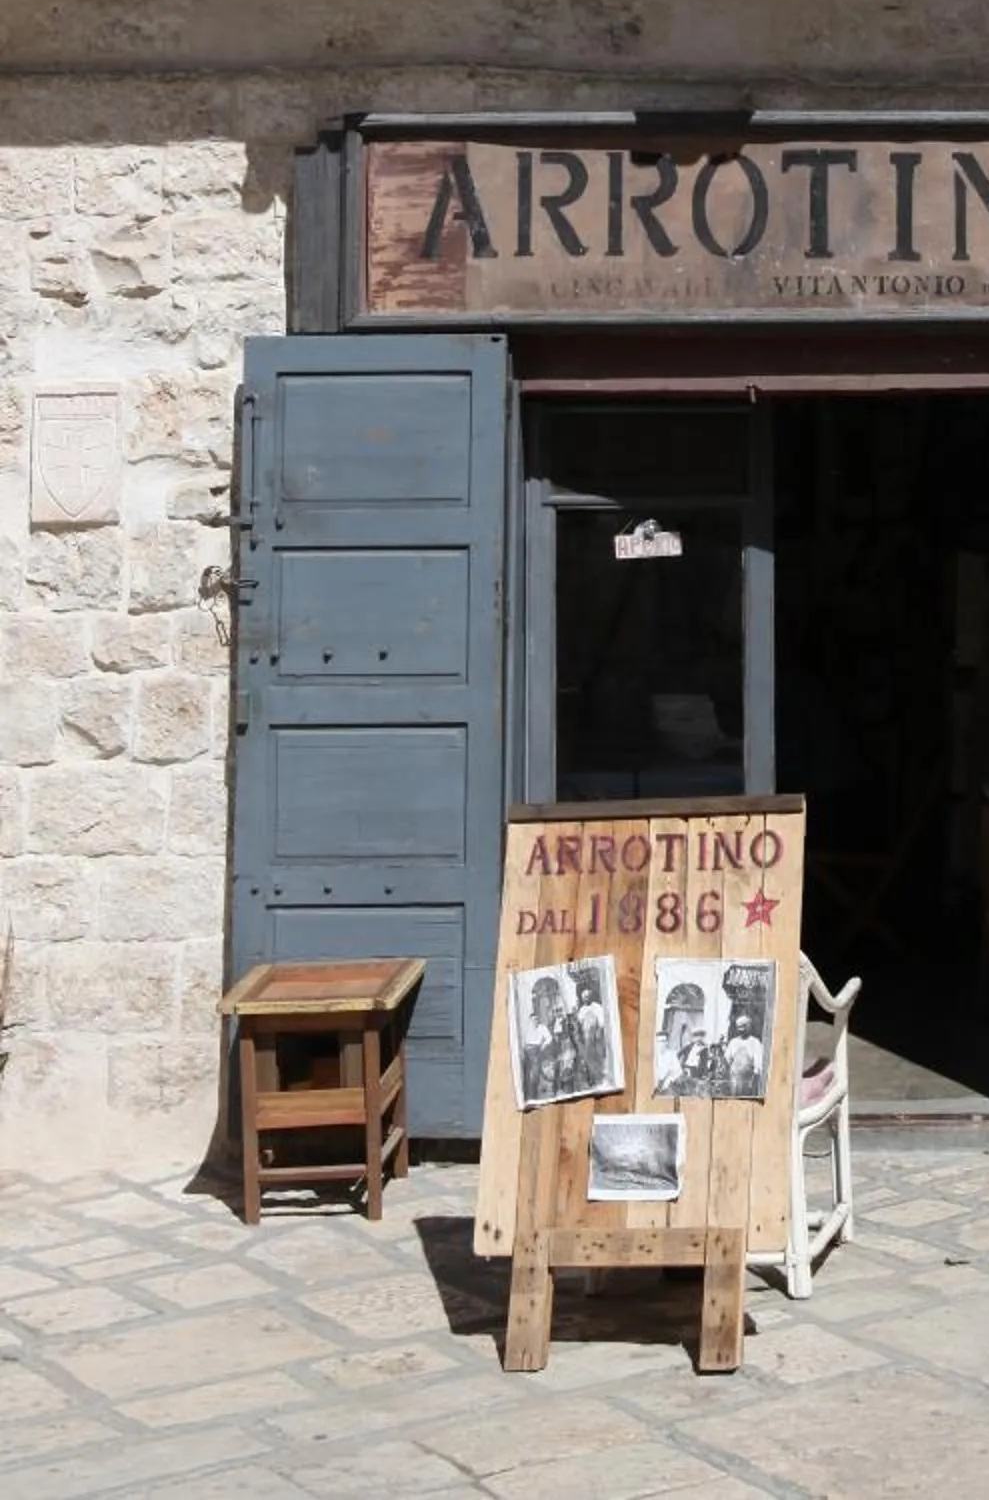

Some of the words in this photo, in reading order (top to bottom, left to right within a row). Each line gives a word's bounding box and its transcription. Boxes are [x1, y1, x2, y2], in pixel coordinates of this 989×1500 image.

[773, 274, 966, 296] VITANTONIO
[525, 829, 786, 876] ARROTINO
[515, 908, 578, 936] DAL
[588, 889, 722, 936] 1886
